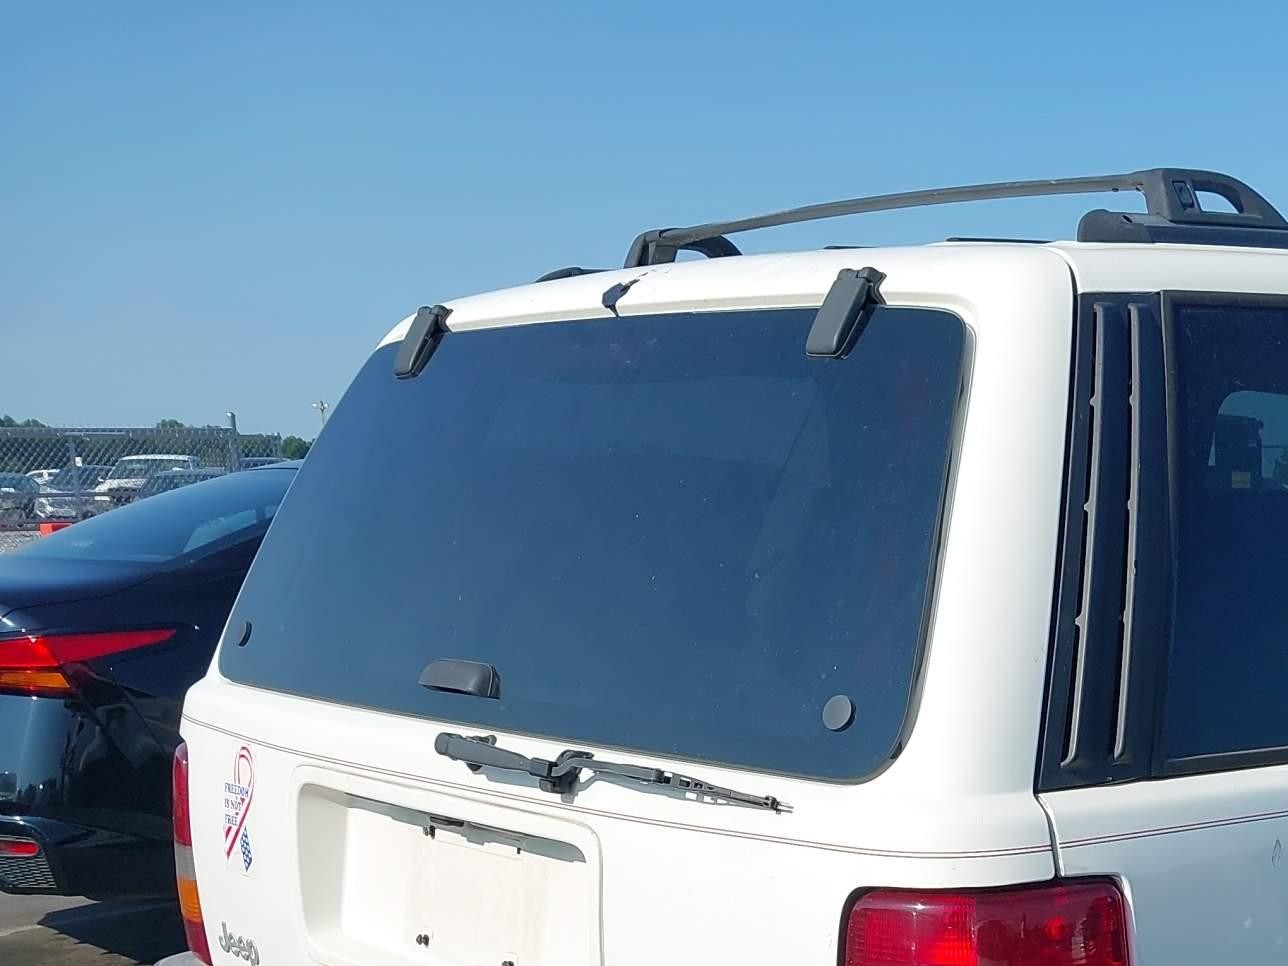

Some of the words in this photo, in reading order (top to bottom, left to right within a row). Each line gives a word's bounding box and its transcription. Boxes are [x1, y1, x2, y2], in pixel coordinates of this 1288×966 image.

[224, 782, 249, 798] FREEDOM
[224, 798, 230, 809] IS
[230, 799, 241, 811] NOT
[224, 814, 238, 826] FREE
